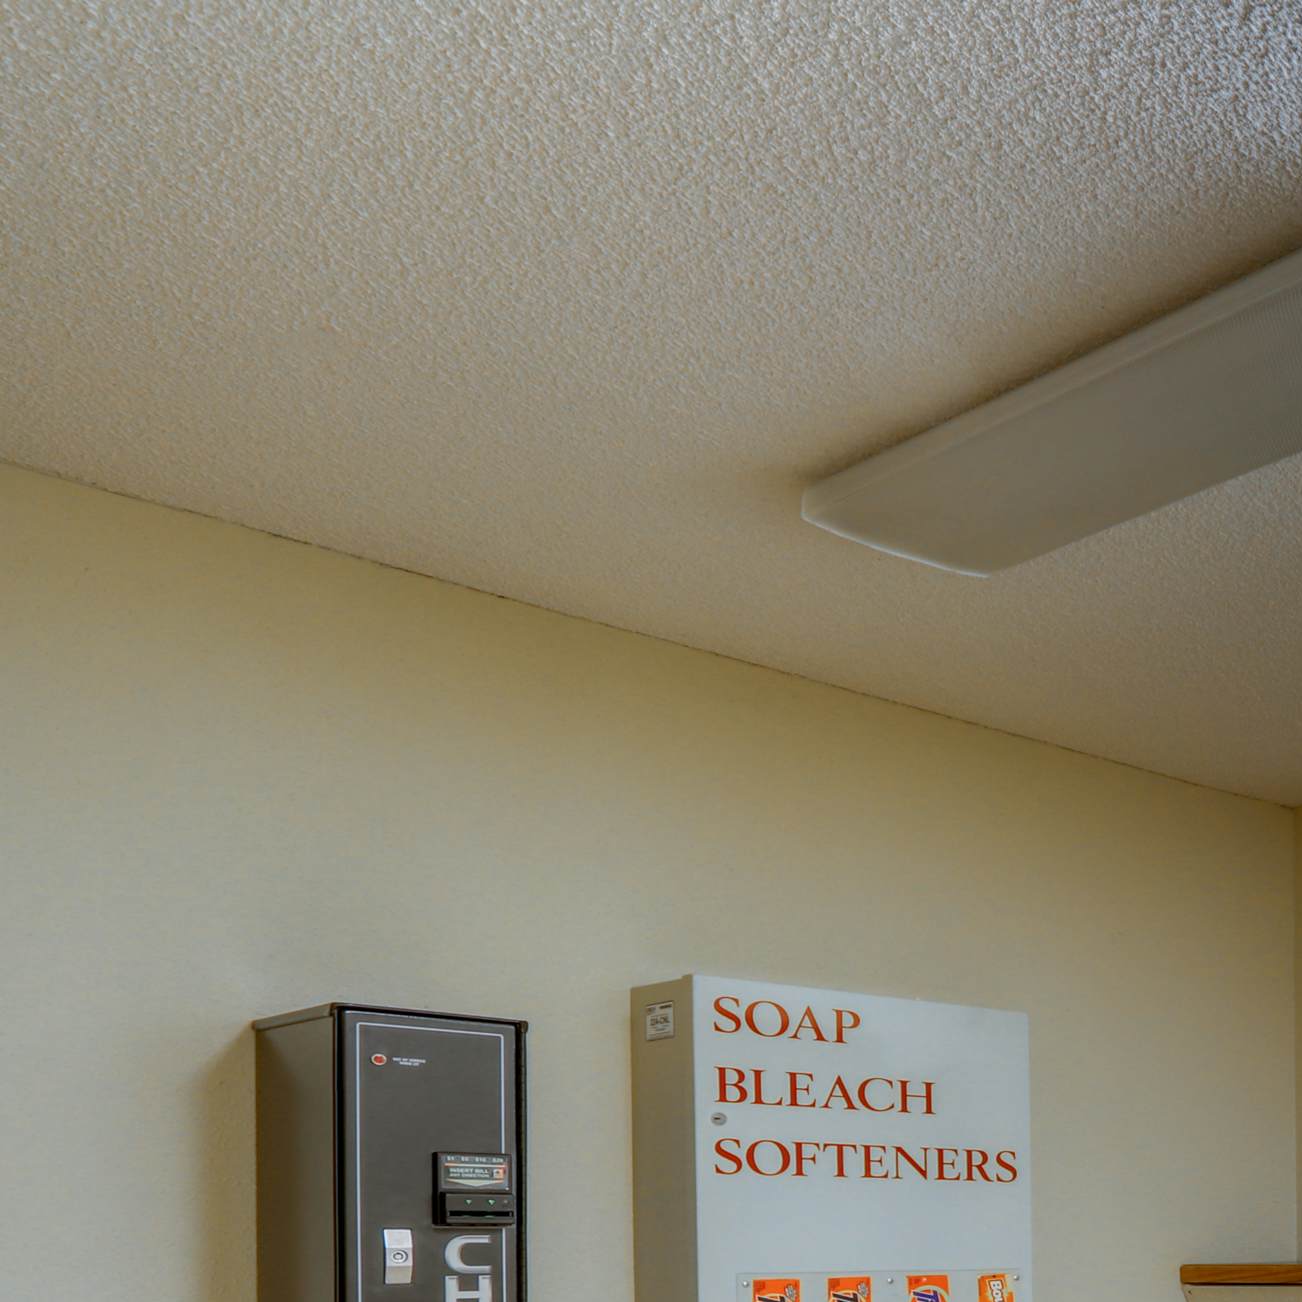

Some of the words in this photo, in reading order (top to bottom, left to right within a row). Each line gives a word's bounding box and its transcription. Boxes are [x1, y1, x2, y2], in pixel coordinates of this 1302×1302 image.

[712, 996, 862, 1044] SOAP
[714, 1066, 936, 1114] BLEACH
[713, 1137, 1018, 1184] SOFTENERS
